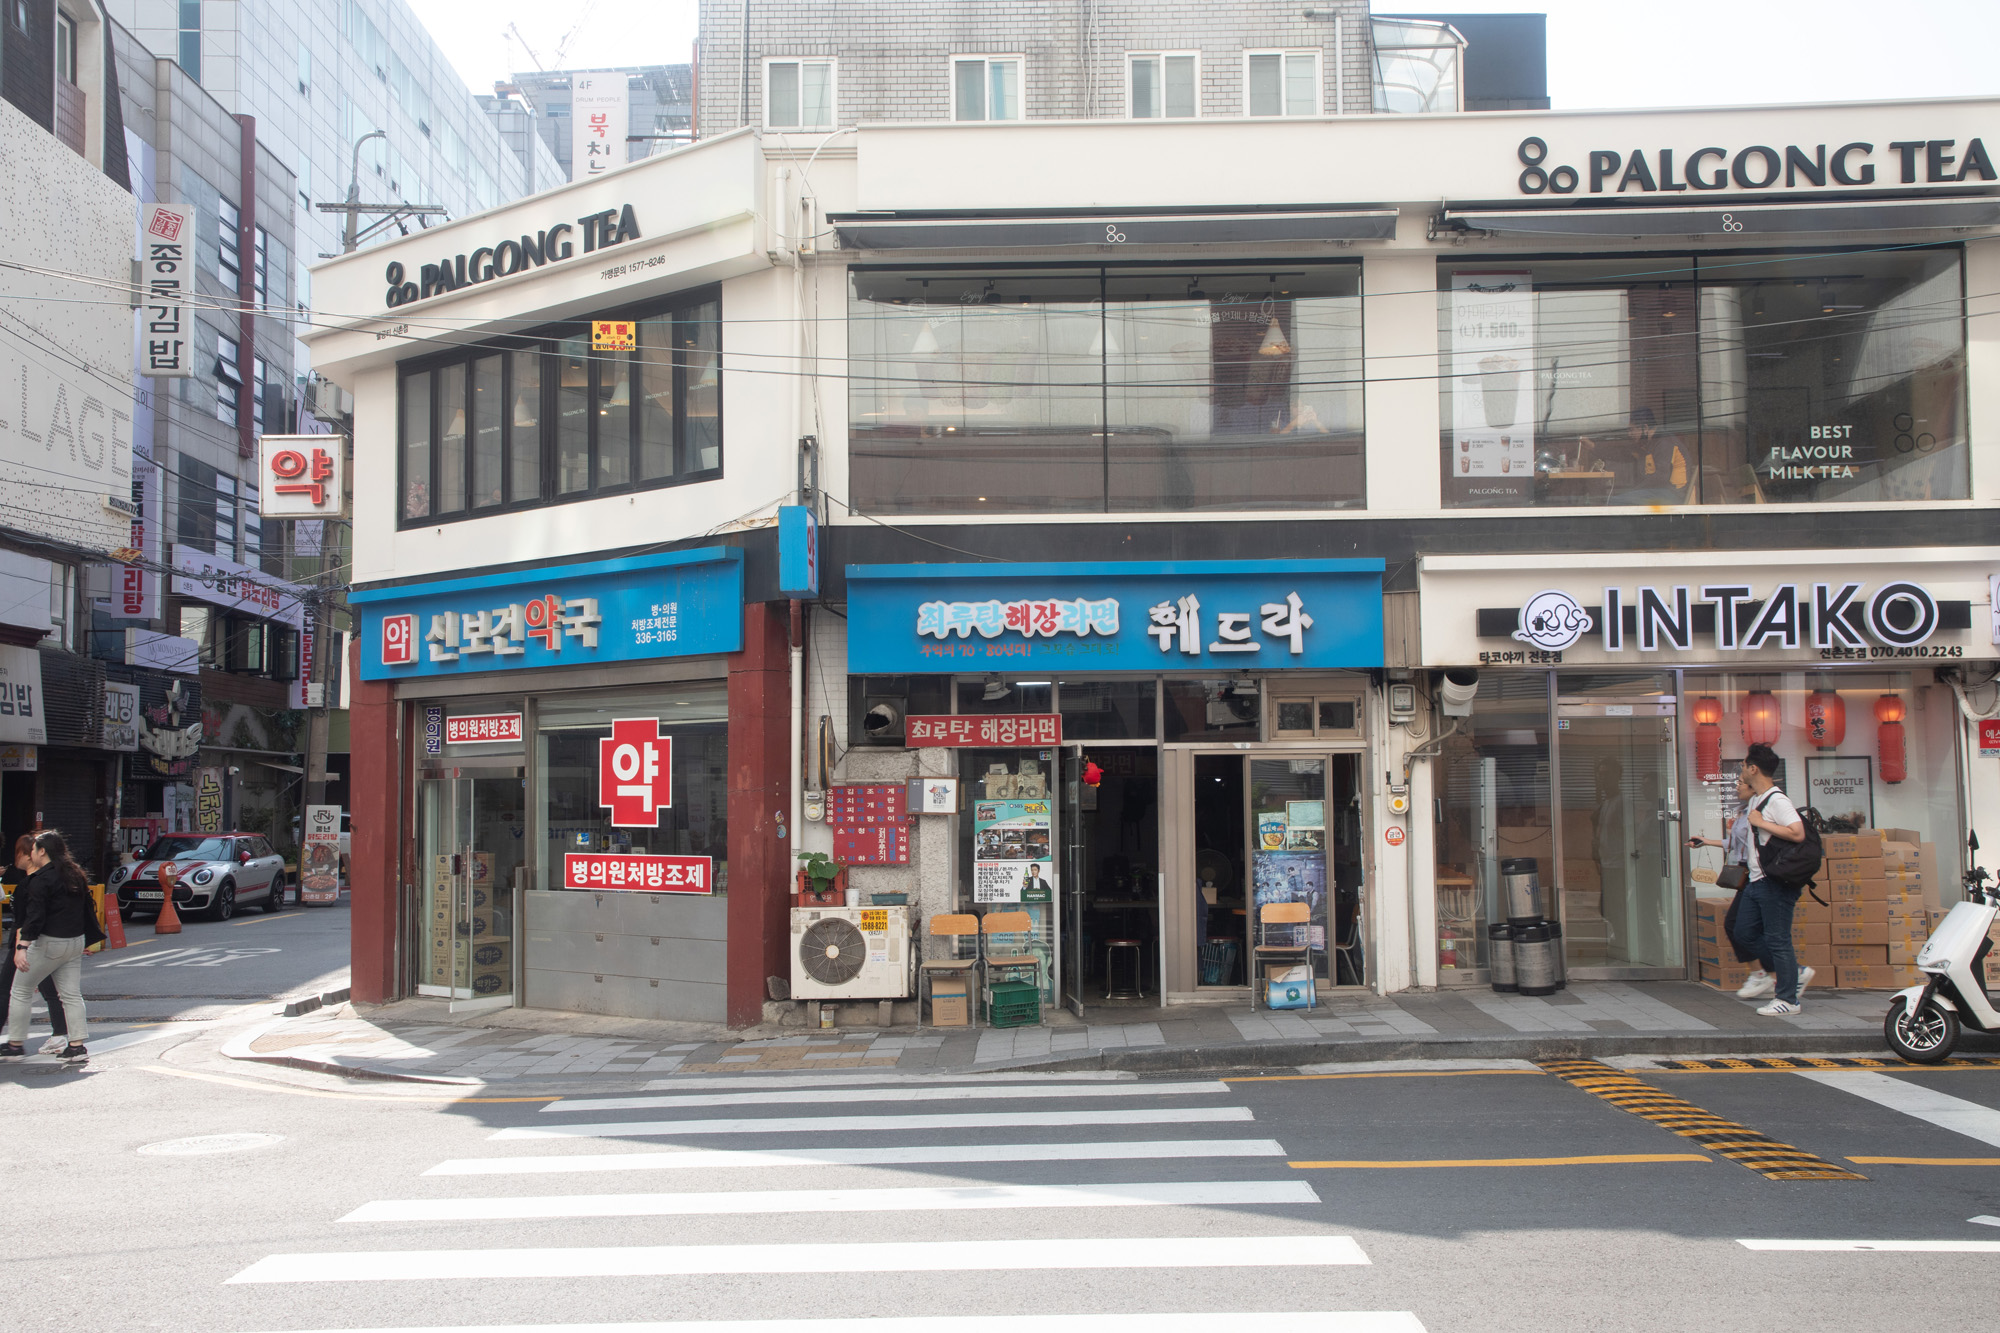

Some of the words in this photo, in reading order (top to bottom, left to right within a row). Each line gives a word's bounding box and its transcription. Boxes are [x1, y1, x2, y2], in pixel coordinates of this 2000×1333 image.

[579, 81, 592, 90] 4F
[1589, 141, 1875, 193] PALGONG
[1889, 137, 1999, 183] TEA
[420, 222, 573, 300] PALGONG
[578, 203, 642, 254] TEA
[600, 263, 628, 281] 가맹문의
[627, 254, 666, 273] 1577-8246
[1220, 291, 1250, 304] Enjoy!
[1811, 425, 1853, 439] BEST
[1771, 446, 1853, 460] FLAVOUR
[270, 448, 334, 504] 약
[1770, 466, 1815, 479] MILK
[1819, 465, 1854, 479] TEA
[1505, 487, 1518, 495] TEA
[651, 602, 678, 616] 병·의원
[1603, 581, 1939, 651] INTAKO
[425, 594, 602, 662] 신보건약국
[631, 615, 678, 632] 처방조제전문
[1147, 591, 1314, 655] 훼드라
[385, 621, 410, 659] 약
[635, 630, 678, 645] 336-3165
[920, 643, 955, 657] 추억의
[957, 644, 976, 657] 70
[1479, 650, 1525, 665] 타코야끼
[1528, 649, 1563, 663] 전문점
[1870, 645, 1964, 659] 070.4010.2243
[426, 706, 442, 754] 병의원
[449, 717, 521, 740] 병의원처방조제
[911, 719, 975, 743] 최루탄
[980, 717, 1057, 743] 해장라면
[611, 741, 659, 813] 약
[1823, 786, 1855, 794] COFFEE
[1833, 777, 1864, 785] BOTTLE
[826, 788, 834, 823] 오징어볶음
[846, 788, 855, 823] 김치찌개
[866, 788, 875, 823] 조개탕
[887, 788, 896, 822] 계란말이
[898, 827, 907, 862] 낙지볶음
[572, 860, 704, 889] 병의원처방조제
[862, 922, 887, 931] 1588-8221
